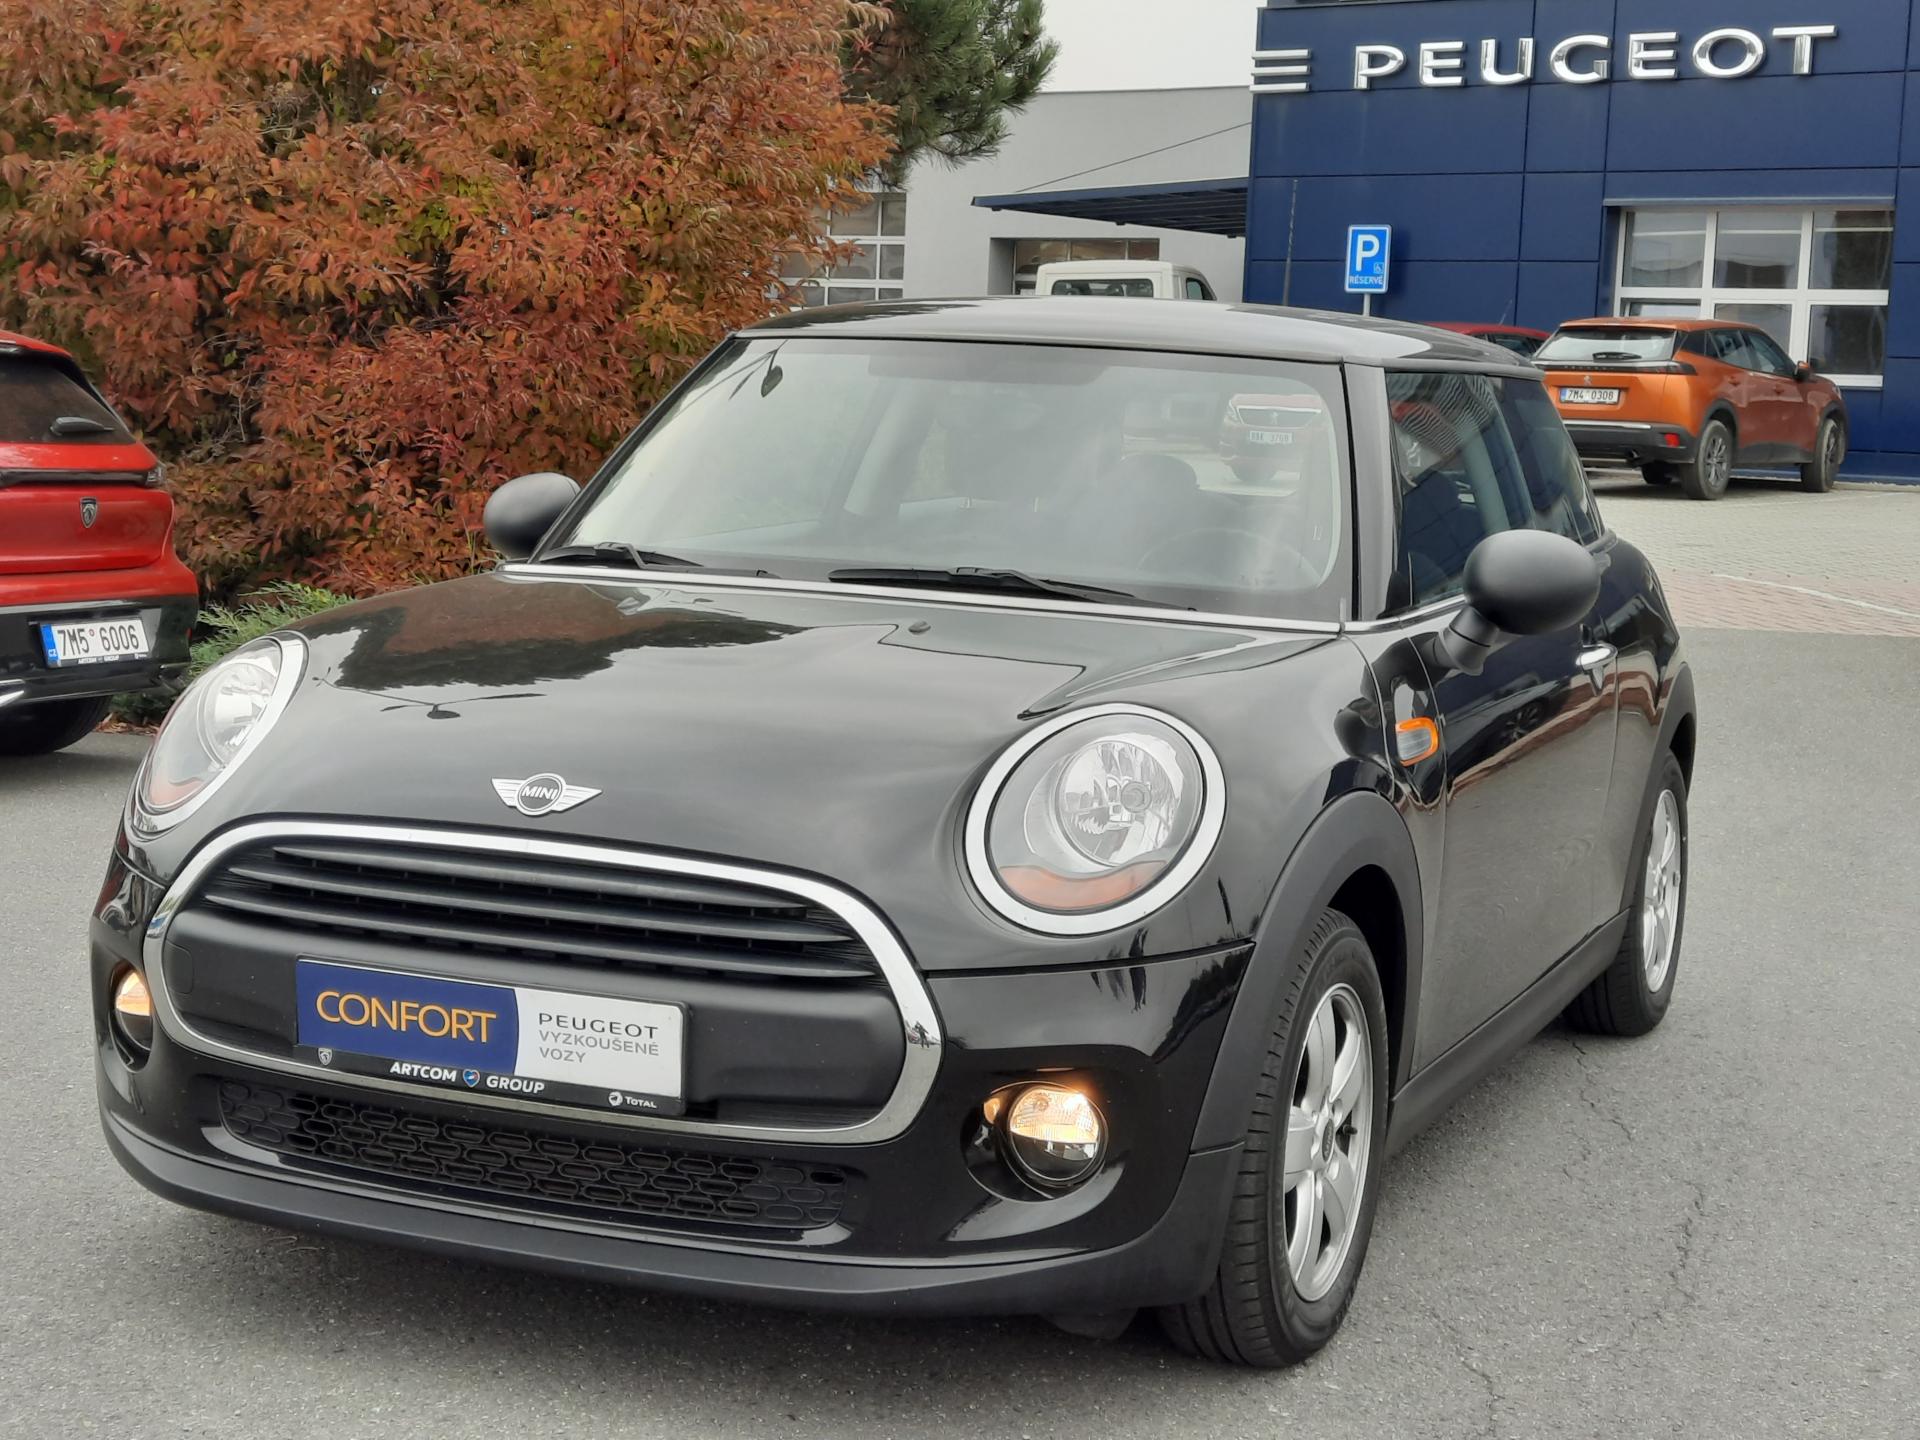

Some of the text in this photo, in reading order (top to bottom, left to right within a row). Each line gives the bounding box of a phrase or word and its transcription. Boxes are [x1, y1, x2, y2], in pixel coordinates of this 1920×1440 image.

[1353, 25, 1836, 89] PEUGEOT
[1356, 234, 1380, 272] P
[1568, 389, 1584, 399] 7M4
[57, 624, 140, 657] 7M5 6006
[521, 785, 559, 800] MINI
[316, 991, 497, 1043] CONFORT
[539, 1012, 659, 1039] PEUGEOT
[539, 1029, 660, 1056] VYZKOUŠENÉ
[539, 1046, 586, 1063] VOZY
[390, 1061, 545, 1094] ARTCOM GROUP
